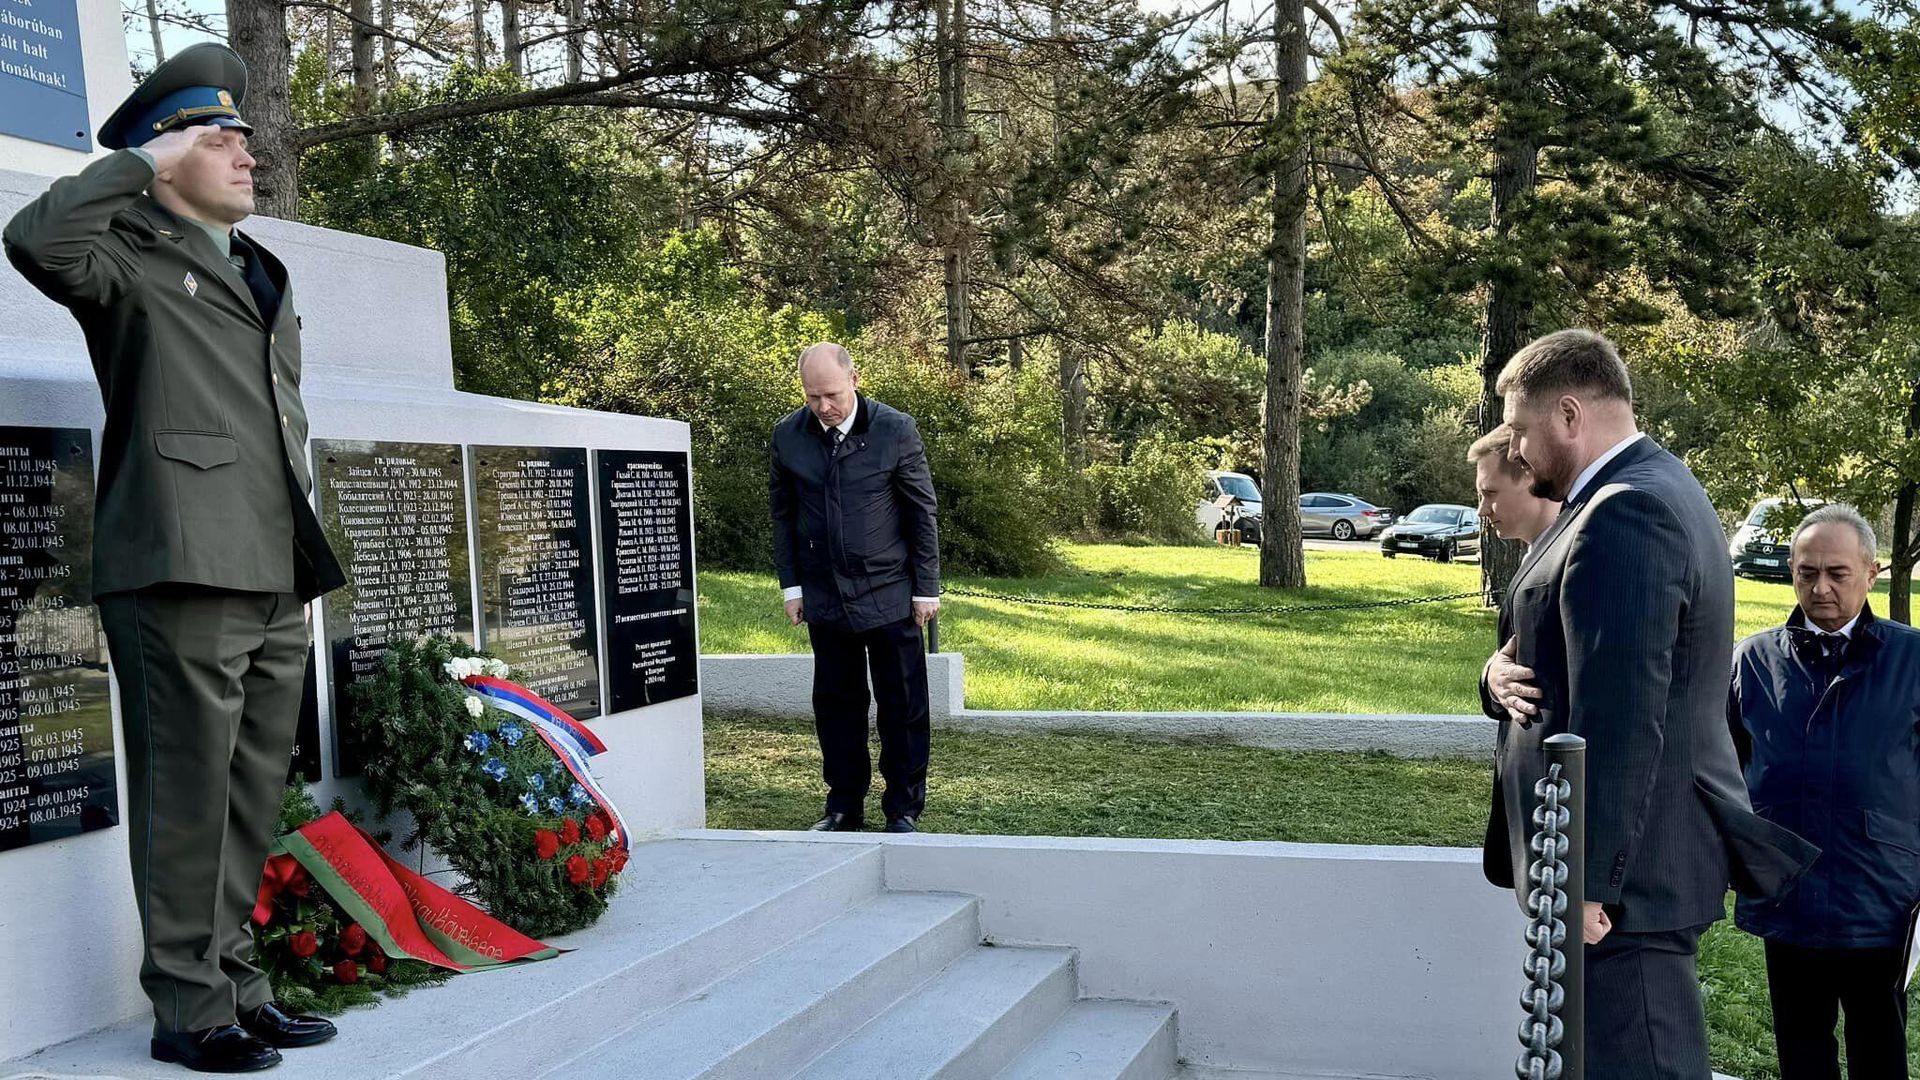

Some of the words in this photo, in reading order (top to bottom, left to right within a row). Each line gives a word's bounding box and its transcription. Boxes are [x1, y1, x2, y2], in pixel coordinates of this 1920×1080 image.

[22, 40, 49, 60] halt
[8, 460, 58, 472] 11.01.1945
[6, 475, 56, 488] 11.12.1944
[403, 491, 416, 500] 1923
[12, 505, 65, 519] 08.01.1945
[403, 503, 417, 511] 1923
[3, 521, 56, 534] 08.01.1945
[11, 535, 65, 549] 20.01.1945
[17, 565, 71, 580] 20.01.1945
[30, 654, 82, 671] 09.01.1945
[22, 684, 75, 700] 09.01.1945
[28, 699, 80, 717] 09.01.1945
[30, 728, 83, 747] 08.03.1945
[31, 742, 83, 762] 07.01.1945
[26, 758, 80, 778] 09.01.1945
[3, 798, 27, 815] 1924
[37, 785, 89, 807] 09.01.1945
[30, 802, 82, 824] 08.01.1945
